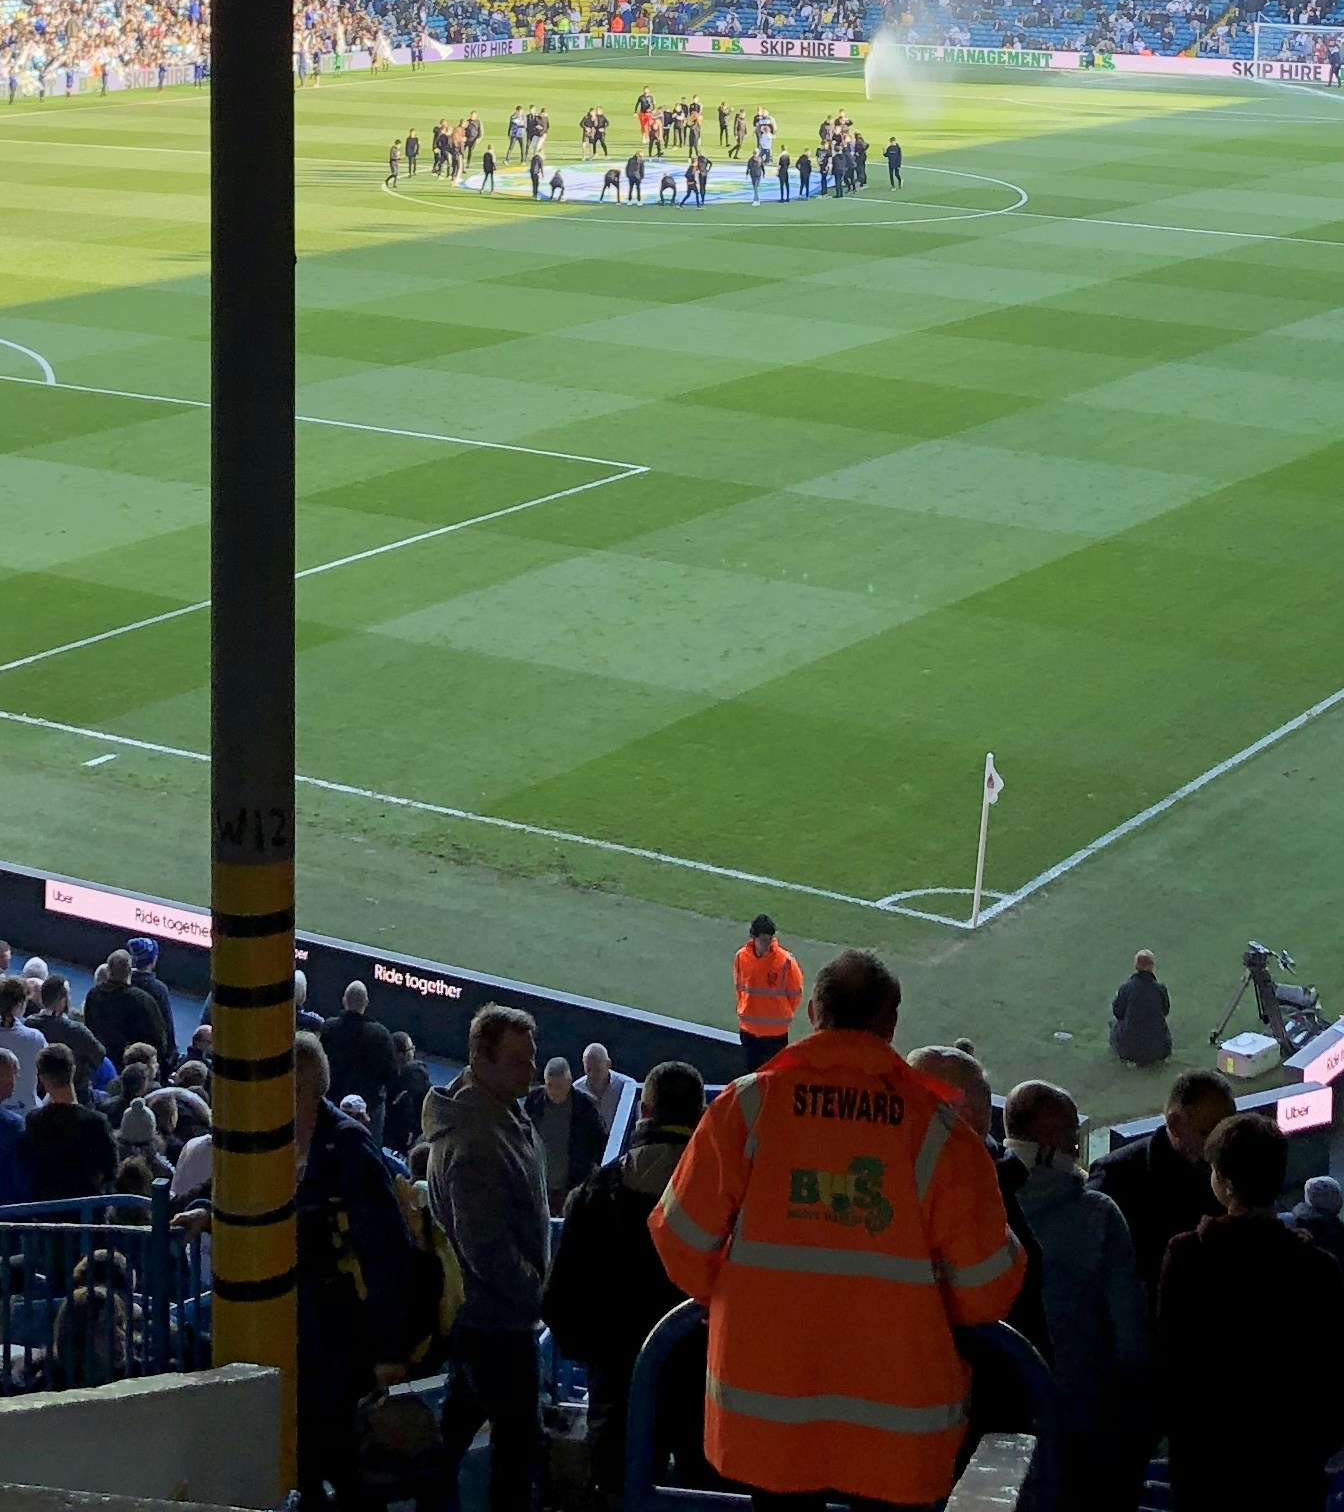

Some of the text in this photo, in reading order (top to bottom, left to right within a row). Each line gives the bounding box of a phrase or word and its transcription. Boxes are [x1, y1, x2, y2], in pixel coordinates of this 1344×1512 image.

[464, 44, 488, 58] SKIP
[490, 41, 513, 57] HIRE
[761, 40, 795, 56] SKIP
[801, 42, 835, 57] HIRE
[944, 48, 1053, 68] MANAGEMENT
[1232, 62, 1274, 80] SKIP
[1280, 64, 1322, 82] HIRE
[125, 71, 155, 89] SKIP
[52, 890, 73, 905] Uber
[135, 908, 160, 928] Ride
[374, 964, 403, 985] Ride
[405, 972, 462, 999] together
[793, 1083, 905, 1126] STEWARD
[1285, 1104, 1310, 1120] Uber
